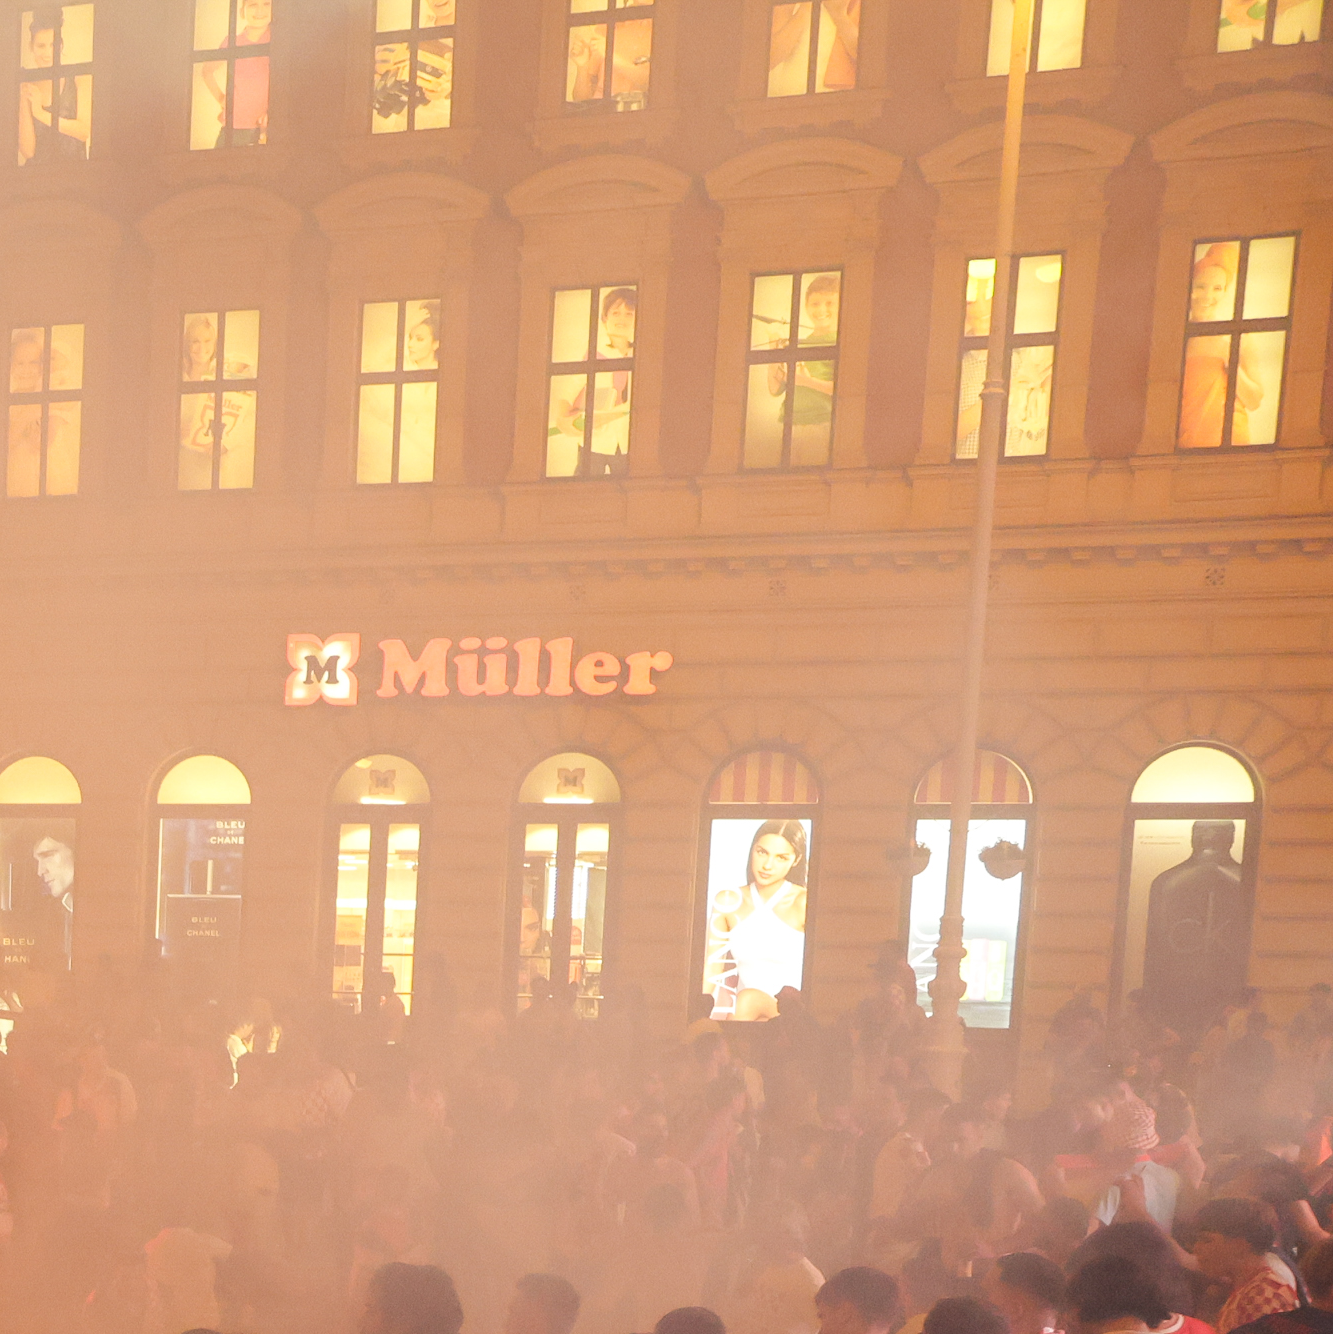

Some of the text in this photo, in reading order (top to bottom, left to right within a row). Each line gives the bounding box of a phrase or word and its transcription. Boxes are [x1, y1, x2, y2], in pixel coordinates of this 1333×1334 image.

[376, 636, 674, 698] Müller
[215, 821, 245, 829] BLEU
[2, 937, 35, 946] BLEU
[4, 955, 30, 963] HAN
